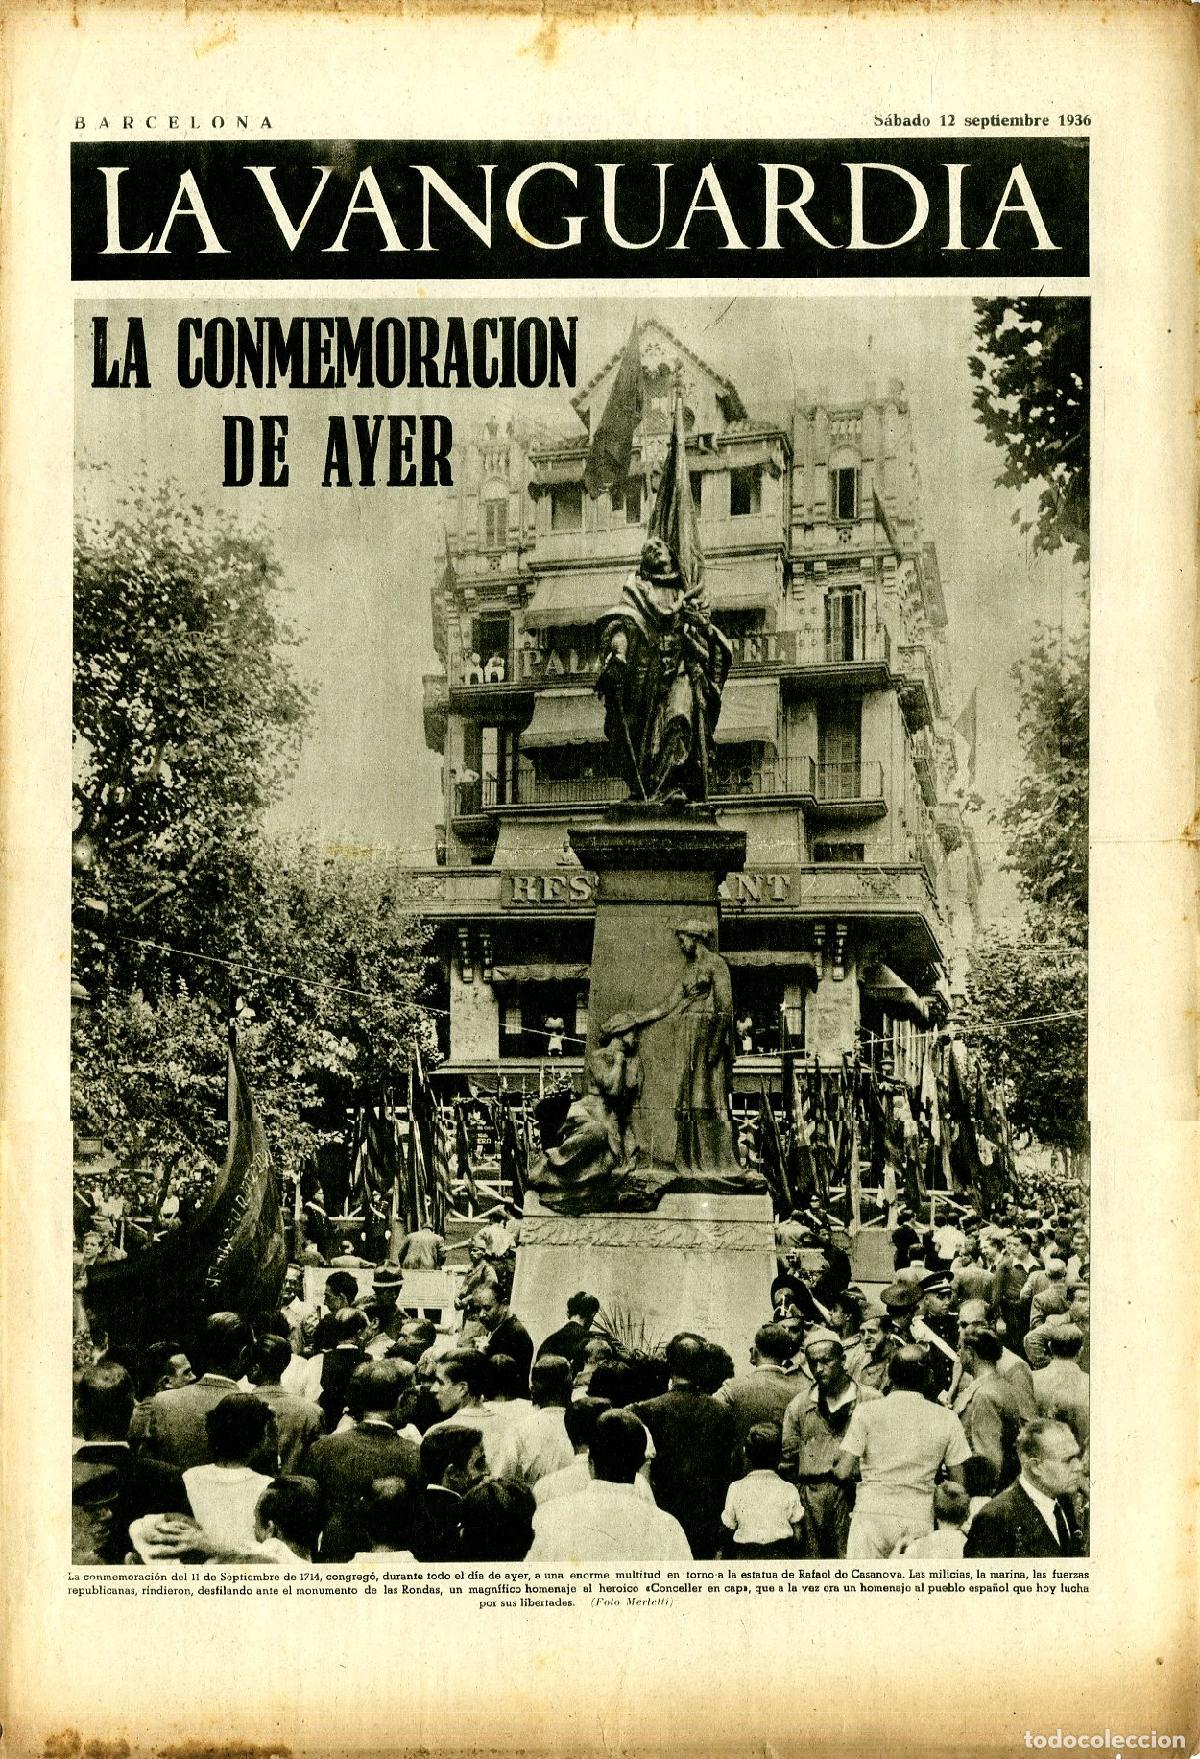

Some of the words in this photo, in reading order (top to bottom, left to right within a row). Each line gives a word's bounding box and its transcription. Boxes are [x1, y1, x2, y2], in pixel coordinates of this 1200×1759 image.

[74, 115, 273, 130] BARCELONA
[874, 113, 931, 127] Sábado
[940, 114, 956, 127] 12
[964, 113, 1050, 128] septiembre
[1058, 114, 1092, 127] 1936
[99, 166, 231, 256] LA
[245, 161, 1063, 252] VANGUARDIA
[90, 316, 152, 388] LA
[177, 315, 579, 390] CONMEMORACION
[222, 415, 290, 487] DE
[321, 414, 454, 489] AYER
[83, 1572, 168, 1581] conmemoración
[171, 1572, 187, 1581] del
[203, 1572, 217, 1581] de
[283, 1572, 297, 1581] de
[325, 1571, 379, 1583] congregó,
[382, 1571, 423, 1581] durante
[426, 1571, 451, 1580] todo
[454, 1570, 465, 1580] el
[467, 1570, 485, 1580] día
[488, 1570, 501, 1580] de
[504, 1573, 531, 1582] ayer,
[569, 1571, 610, 1579] enorme
[615, 1569, 661, 1579] multitud
[686, 1571, 715, 1579] torno
[727, 1569, 737, 1579] la
[740, 1571, 778, 1579] estatua
[781, 1569, 795, 1579] de
[798, 1569, 831, 1579] Rafael
[834, 1569, 849, 1579] de
[851, 1568, 905, 1579] Casanova.
[908, 1569, 926, 1580] Las
[928, 1568, 973, 1580] milicias,
[976, 1569, 987, 1579] la
[989, 1569, 1029, 1580] marina,
[1032, 1569, 1047, 1579] las
[1052, 1569, 1090, 1579] fuerzas
[67, 1585, 138, 1597] republicanas,
[142, 1585, 194, 1597] rindieron,
[197, 1585, 253, 1597] desfilando
[255, 1587, 279, 1596] ante
[282, 1585, 293, 1595] el
[296, 1586, 358, 1596] monumento
[364, 1584, 377, 1595] de
[383, 1584, 398, 1595] las
[401, 1584, 443, 1597] Rondas,
[449, 1586, 463, 1594] un
[468, 1583, 522, 1597] magnífico
[524, 1583, 577, 1596] homenaje
[583, 1583, 593, 1593] al
[598, 1583, 639, 1593] heroico
[707, 1585, 721, 1593] en
[755, 1585, 775, 1595] que
[778, 1585, 784, 1593] a
[787, 1582, 798, 1593] la
[801, 1585, 820, 1593] vez
[859, 1582, 912, 1595] homenaje
[914, 1583, 925, 1594] al
[927, 1582, 966, 1595] pueblo
[968, 1582, 1009, 1595] español
[1012, 1585, 1033, 1595] que
[1036, 1582, 1057, 1595] hoy
[1060, 1582, 1090, 1593] lucha
[479, 1601, 497, 1609] por
[520, 1597, 576, 1607] libertades.
